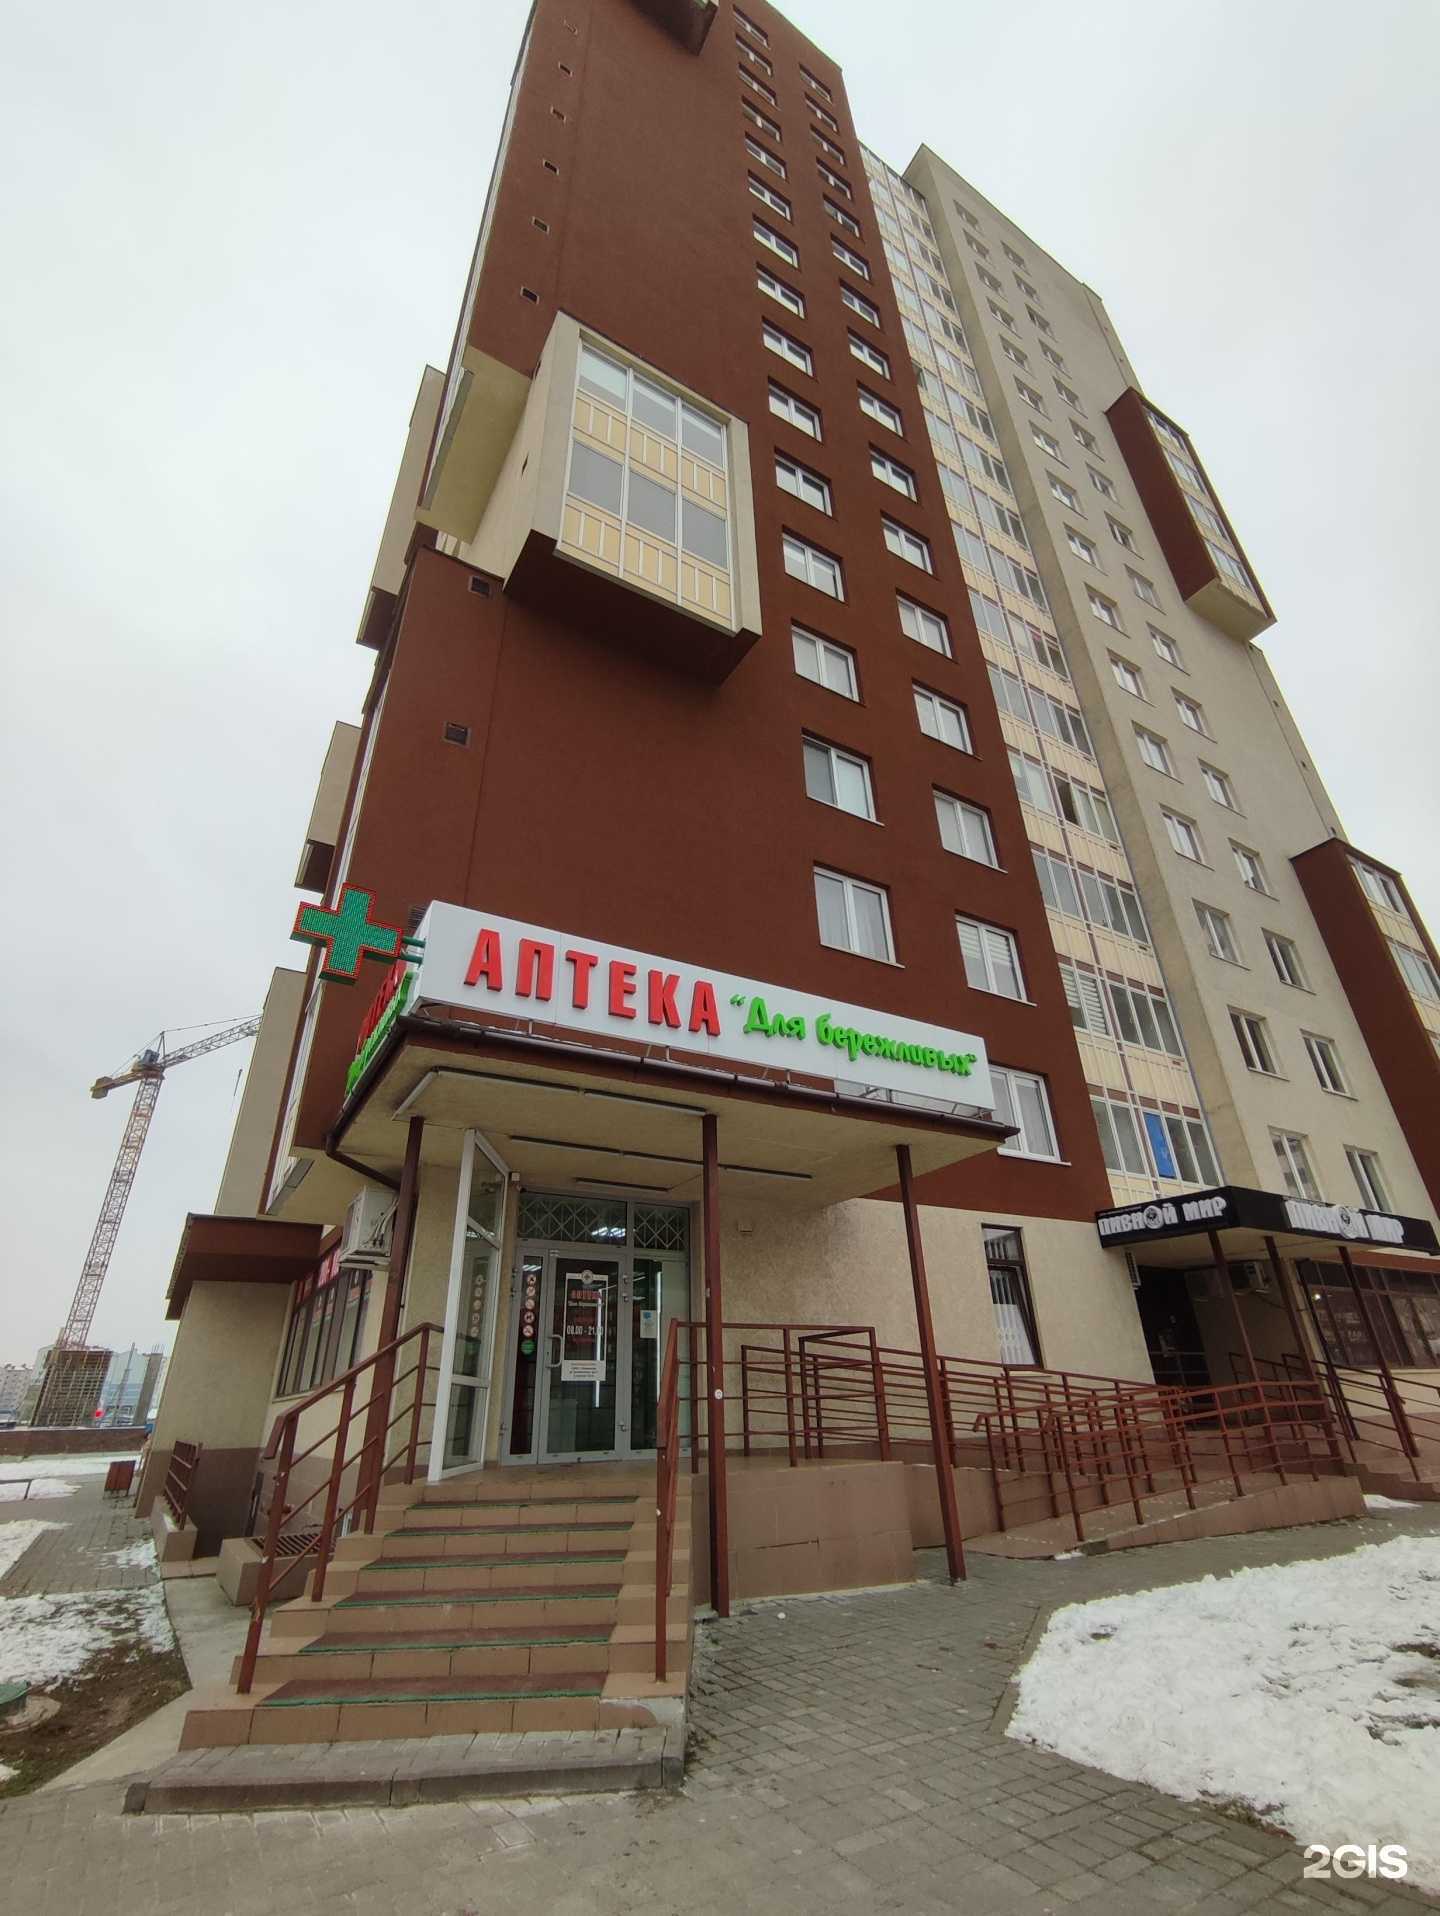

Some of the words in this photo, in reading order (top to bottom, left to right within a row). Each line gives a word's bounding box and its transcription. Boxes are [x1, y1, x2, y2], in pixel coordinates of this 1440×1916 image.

[463, 928, 721, 1037] АПТЕКА
[1098, 1203, 1179, 1235] ПИВНОЙ
[1182, 1196, 1227, 1221] МИР
